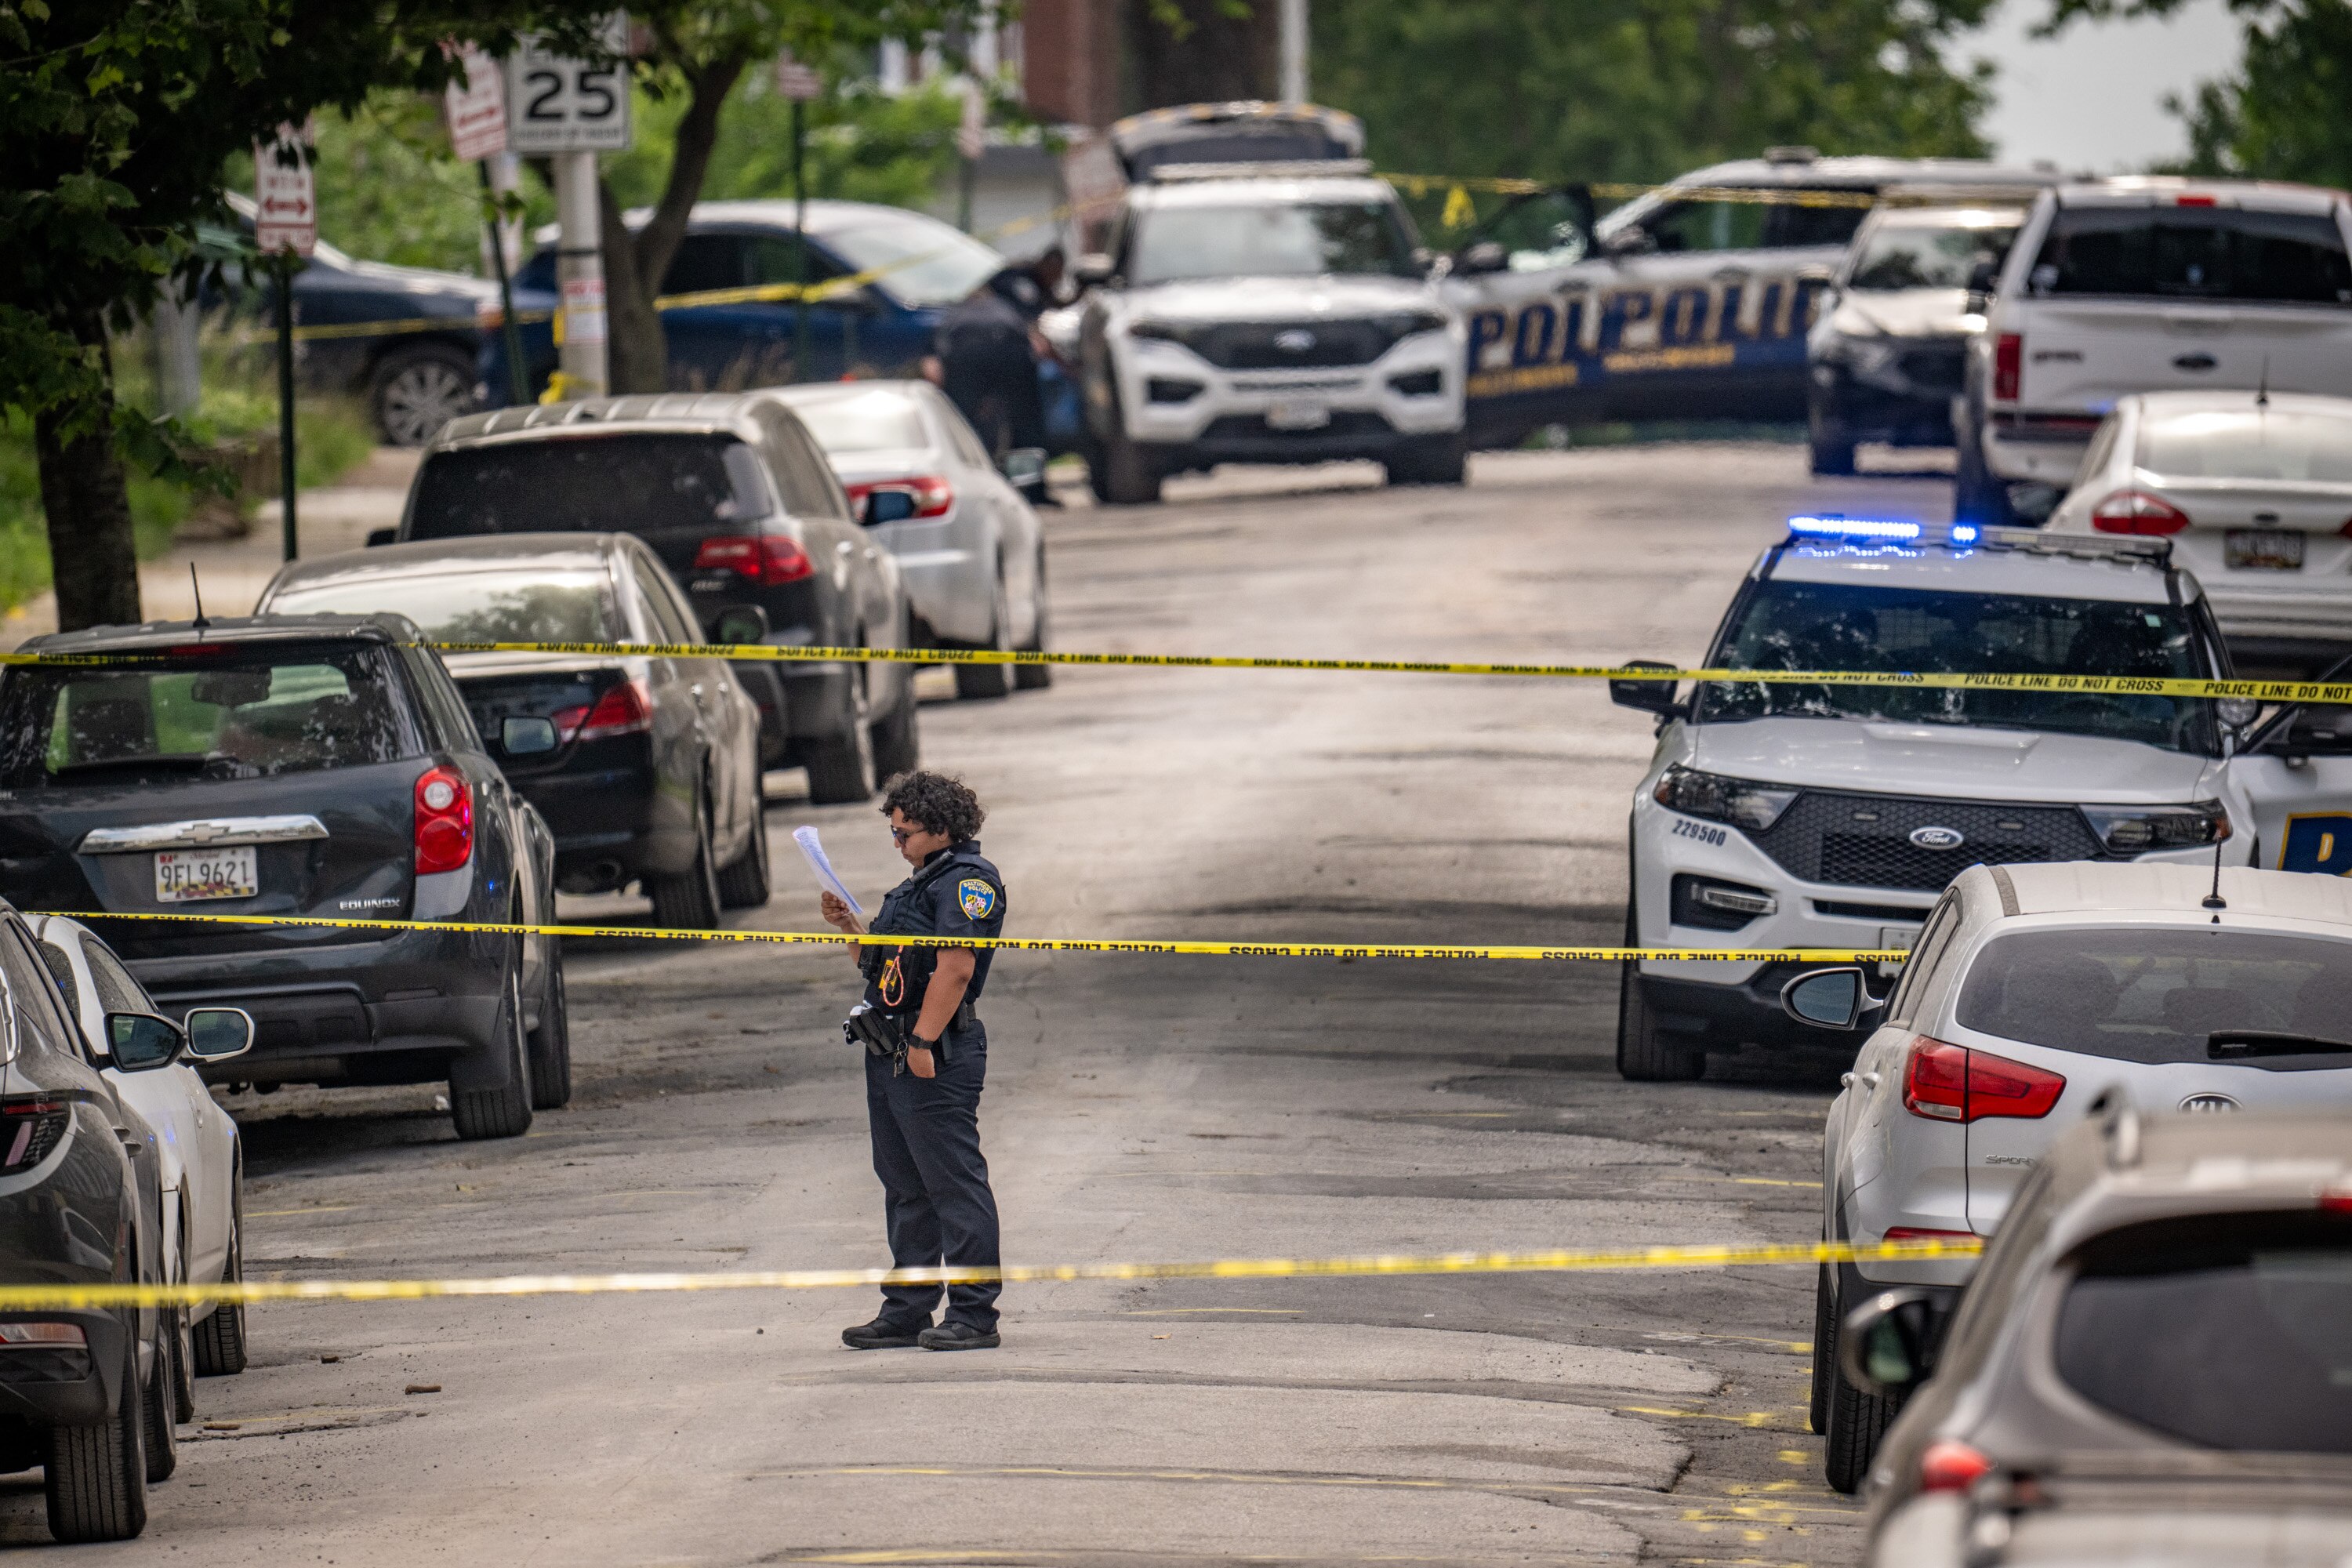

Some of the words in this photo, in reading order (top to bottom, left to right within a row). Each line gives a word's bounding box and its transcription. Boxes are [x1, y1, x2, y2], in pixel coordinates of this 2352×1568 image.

[526, 71, 615, 120] 25
[1964, 673, 2015, 687] POLICE
[2020, 674, 2052, 688] LINE
[2058, 677, 2078, 688] DO
[2082, 677, 2113, 690] NOT
[2116, 679, 2165, 691] CROSS
[2204, 682, 2256, 696] POLICE
[2259, 684, 2294, 698] LINE
[2297, 685, 2319, 699] DO
[2322, 687, 2352, 700] NOT
[1671, 819, 1726, 847] 229500
[161, 861, 248, 893] 9FL9621
[963, 881, 993, 895] BALTIMORE
[968, 886, 988, 895] POLICE
[339, 898, 401, 911] EQUINOX
